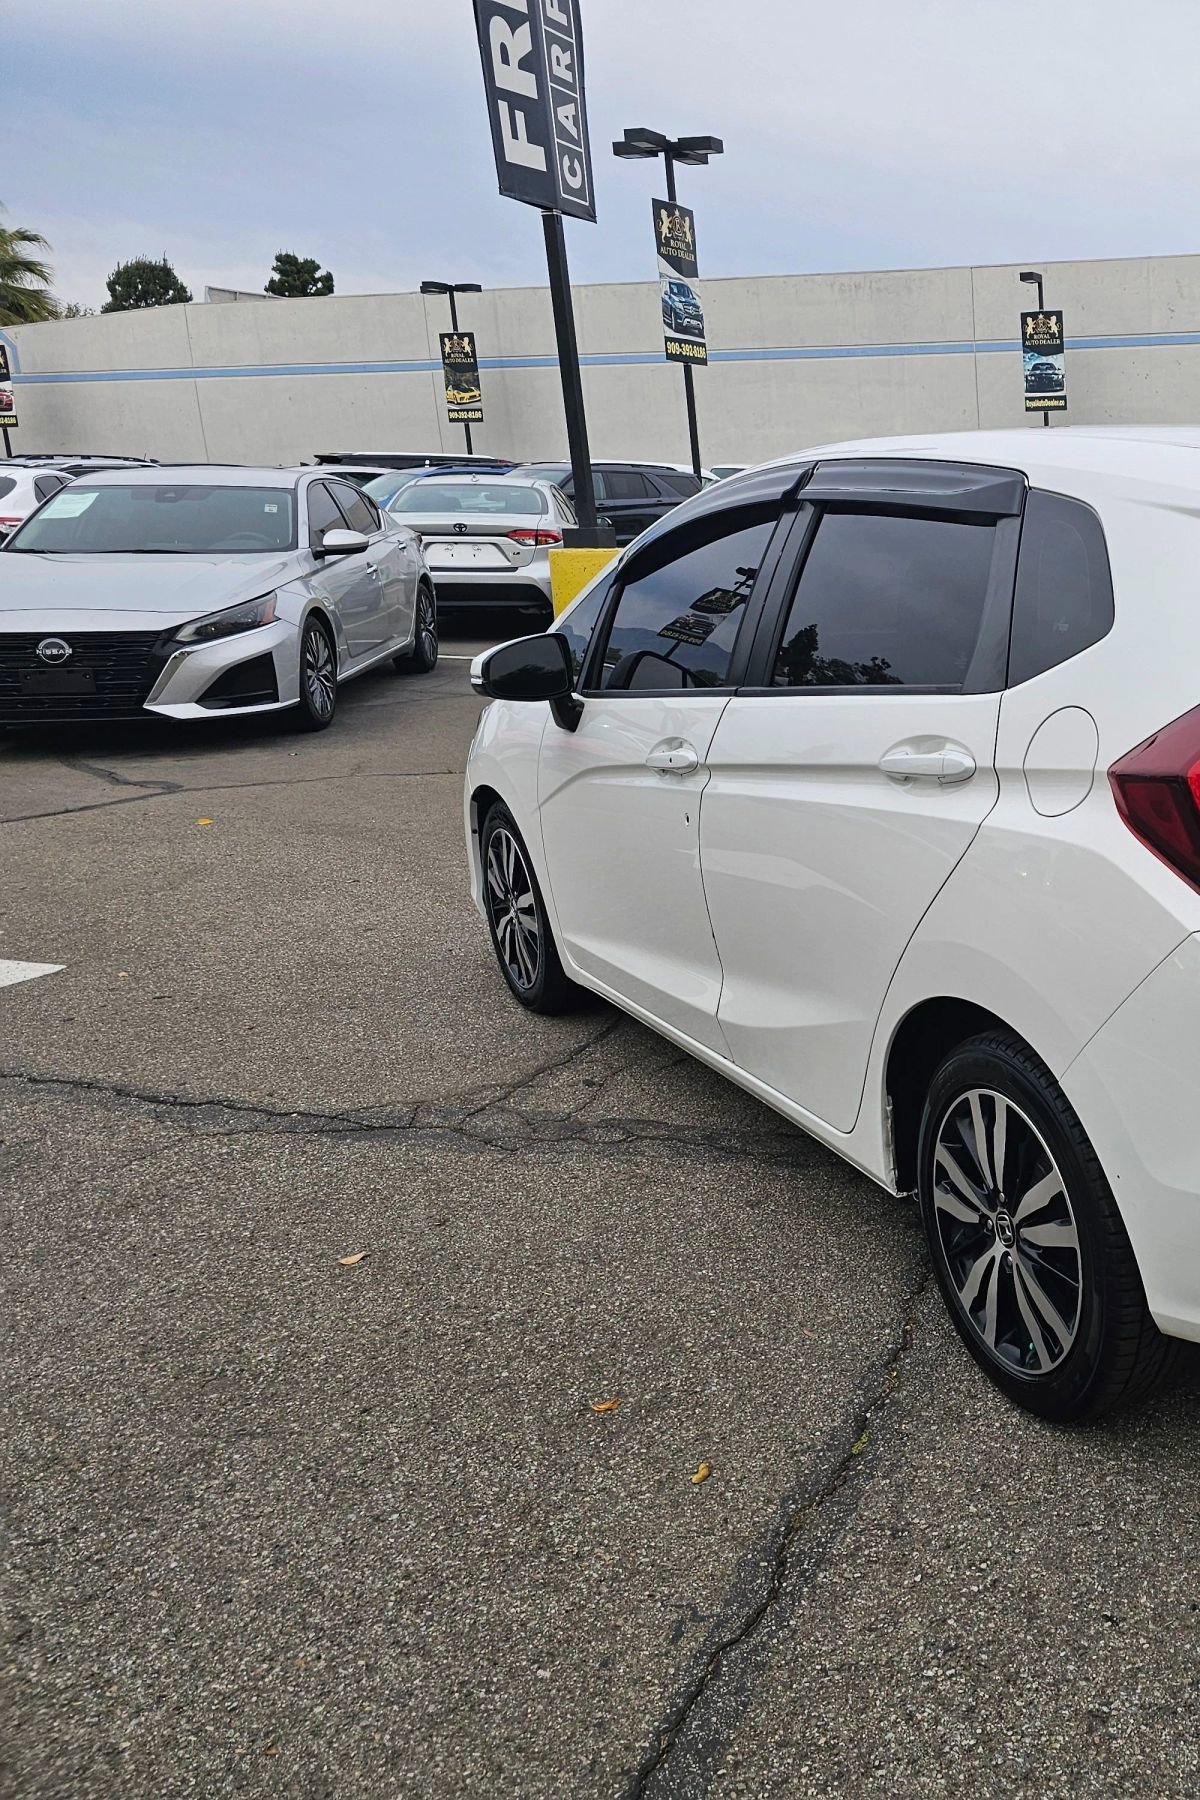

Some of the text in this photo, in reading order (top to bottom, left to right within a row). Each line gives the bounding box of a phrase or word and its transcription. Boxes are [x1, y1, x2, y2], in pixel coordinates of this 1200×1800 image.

[489, 0, 547, 171] FR
[671, 239, 687, 251] ROYAL
[660, 246, 695, 262] AUTO DEALER
